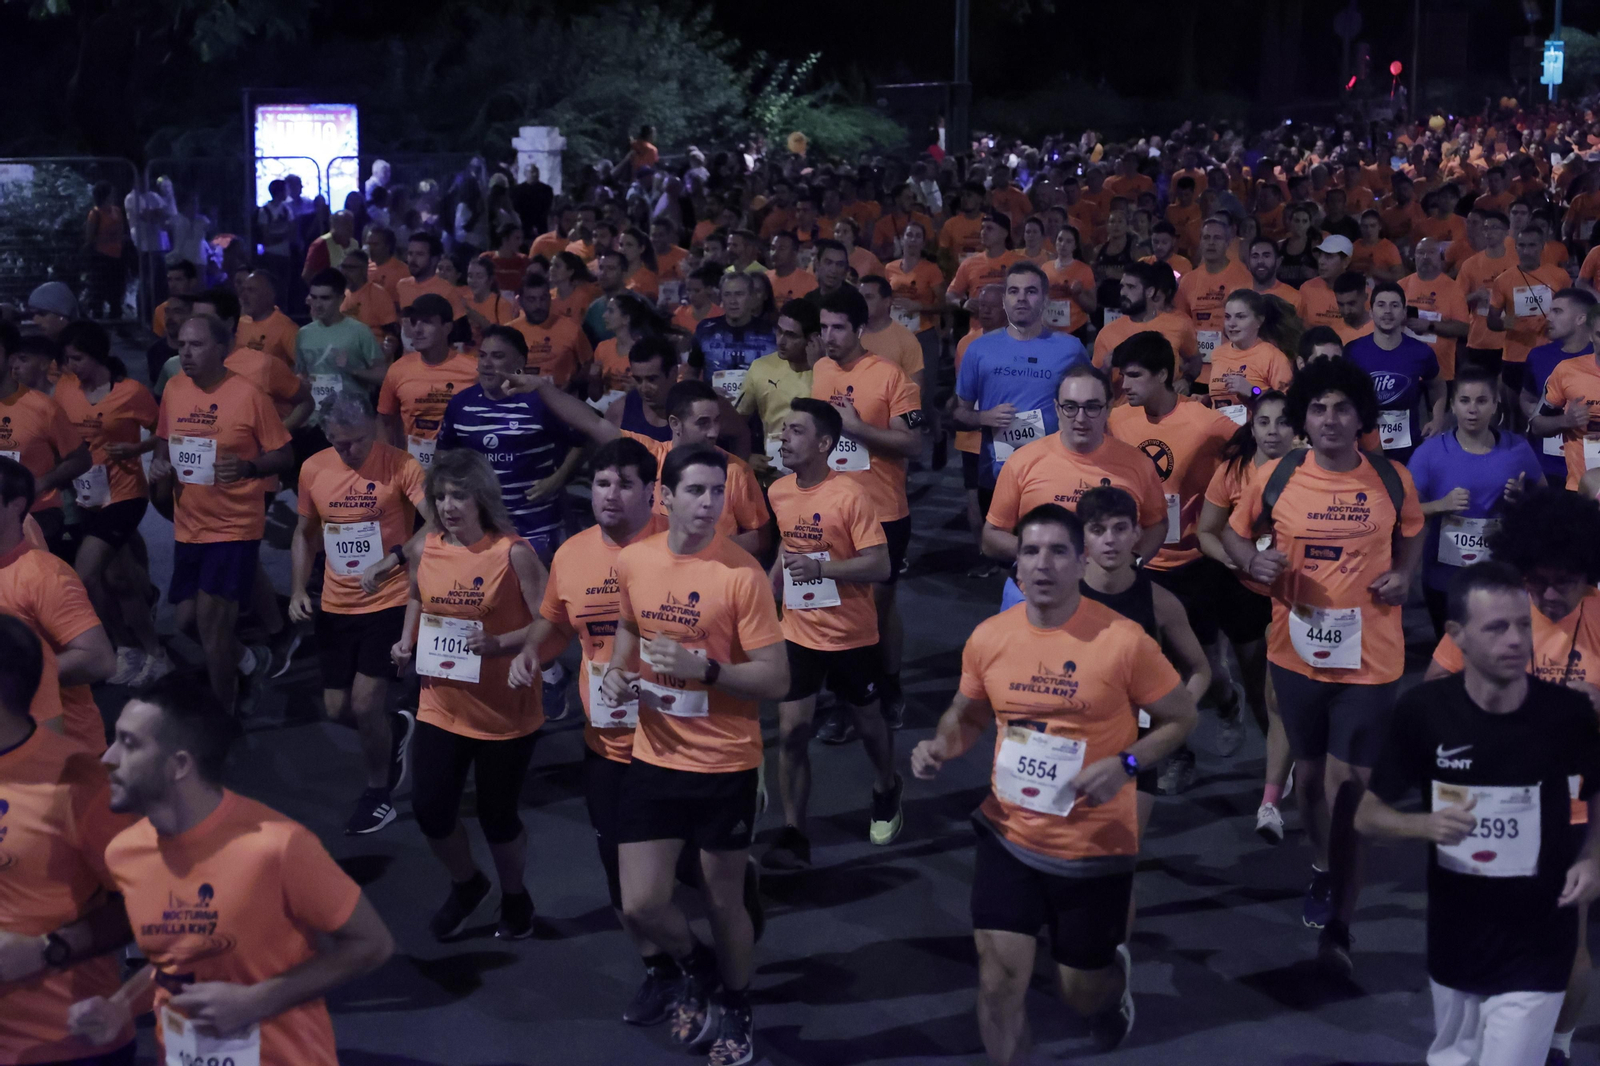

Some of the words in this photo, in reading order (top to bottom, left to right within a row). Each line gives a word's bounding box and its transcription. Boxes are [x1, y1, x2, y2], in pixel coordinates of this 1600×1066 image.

[994, 367, 1052, 380] #Sevilla10
[1003, 427, 1035, 442] 11940
[178, 451, 201, 465] 8901
[1307, 512, 1346, 521] SEVILLA
[1327, 506, 1371, 514] NOCTURNA
[783, 531, 807, 539] SEVILLA
[794, 525, 824, 533] NOCTURNA
[336, 540, 370, 554] 10789
[447, 590, 485, 598] NOCTURNA
[431, 597, 464, 605] SEVILLA
[641, 610, 678, 623] SEVILLA
[660, 604, 701, 618] NOCTURNA
[1306, 627, 1342, 643] 4448
[434, 636, 471, 655] 11014
[1031, 675, 1079, 688] NOCTURNA
[1009, 682, 1052, 695] SEVILLA
[1017, 756, 1057, 781] 5554
[162, 910, 219, 921] NOCTURNA
[142, 924, 186, 936] SEVILLA
